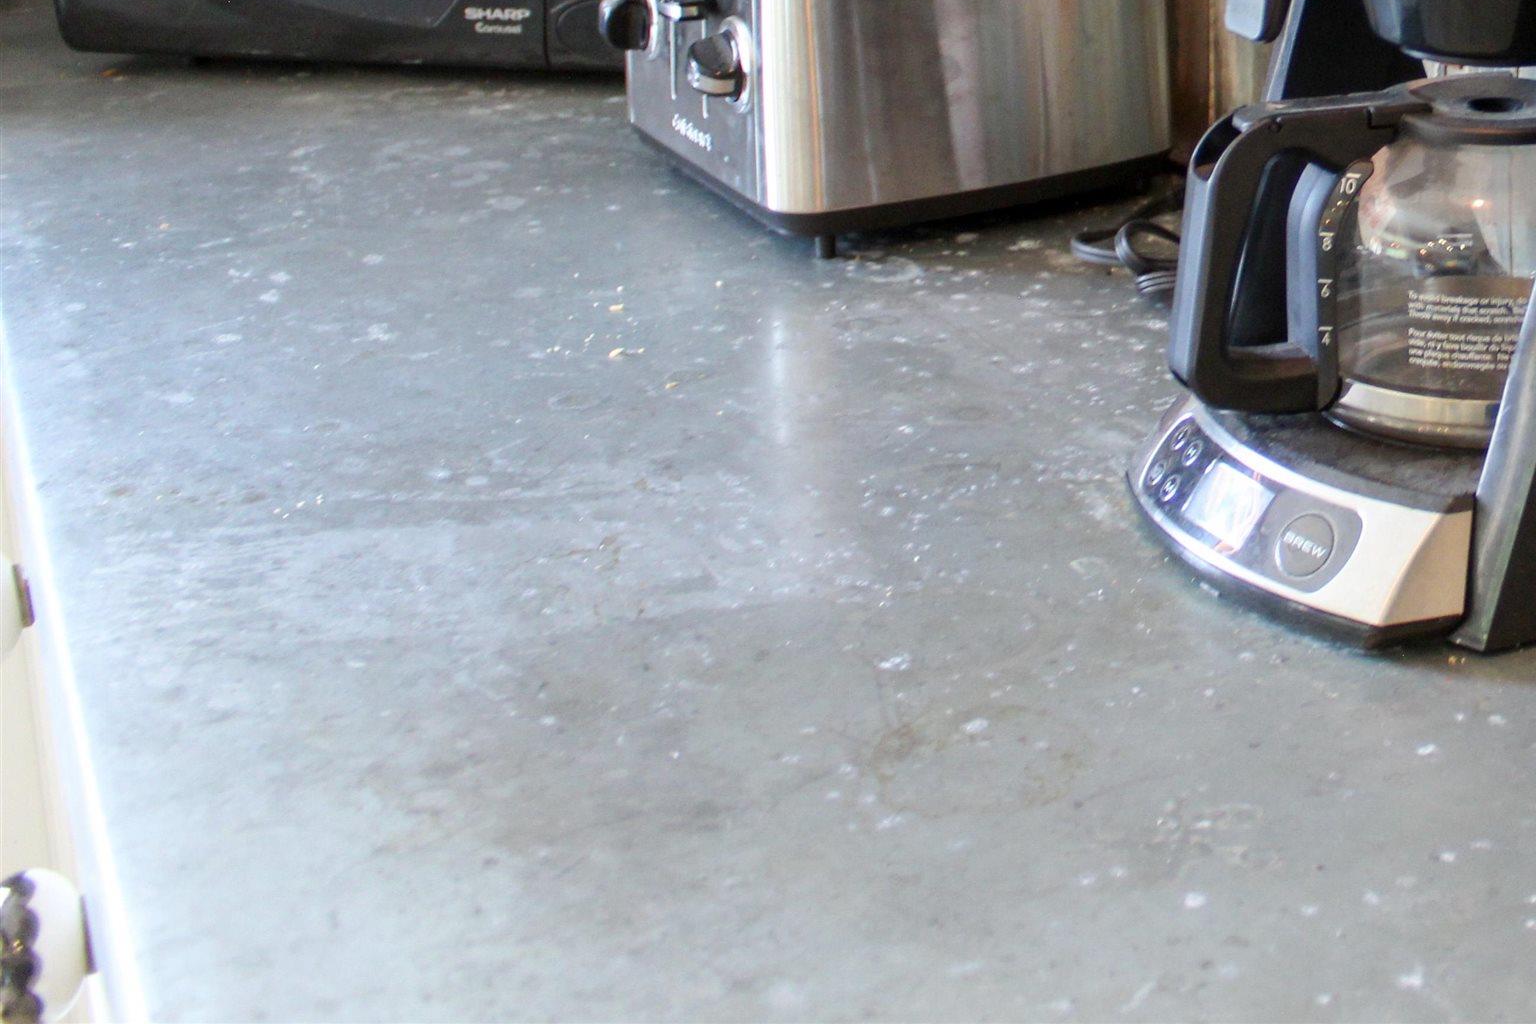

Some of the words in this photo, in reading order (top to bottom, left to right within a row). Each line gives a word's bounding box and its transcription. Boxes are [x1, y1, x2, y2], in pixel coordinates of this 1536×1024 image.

[464, 7, 530, 20] SHARP
[1339, 178, 1357, 194] 10
[1320, 236, 1333, 251] 8
[1320, 284, 1332, 299] 6
[1283, 529, 1328, 559] BREW
